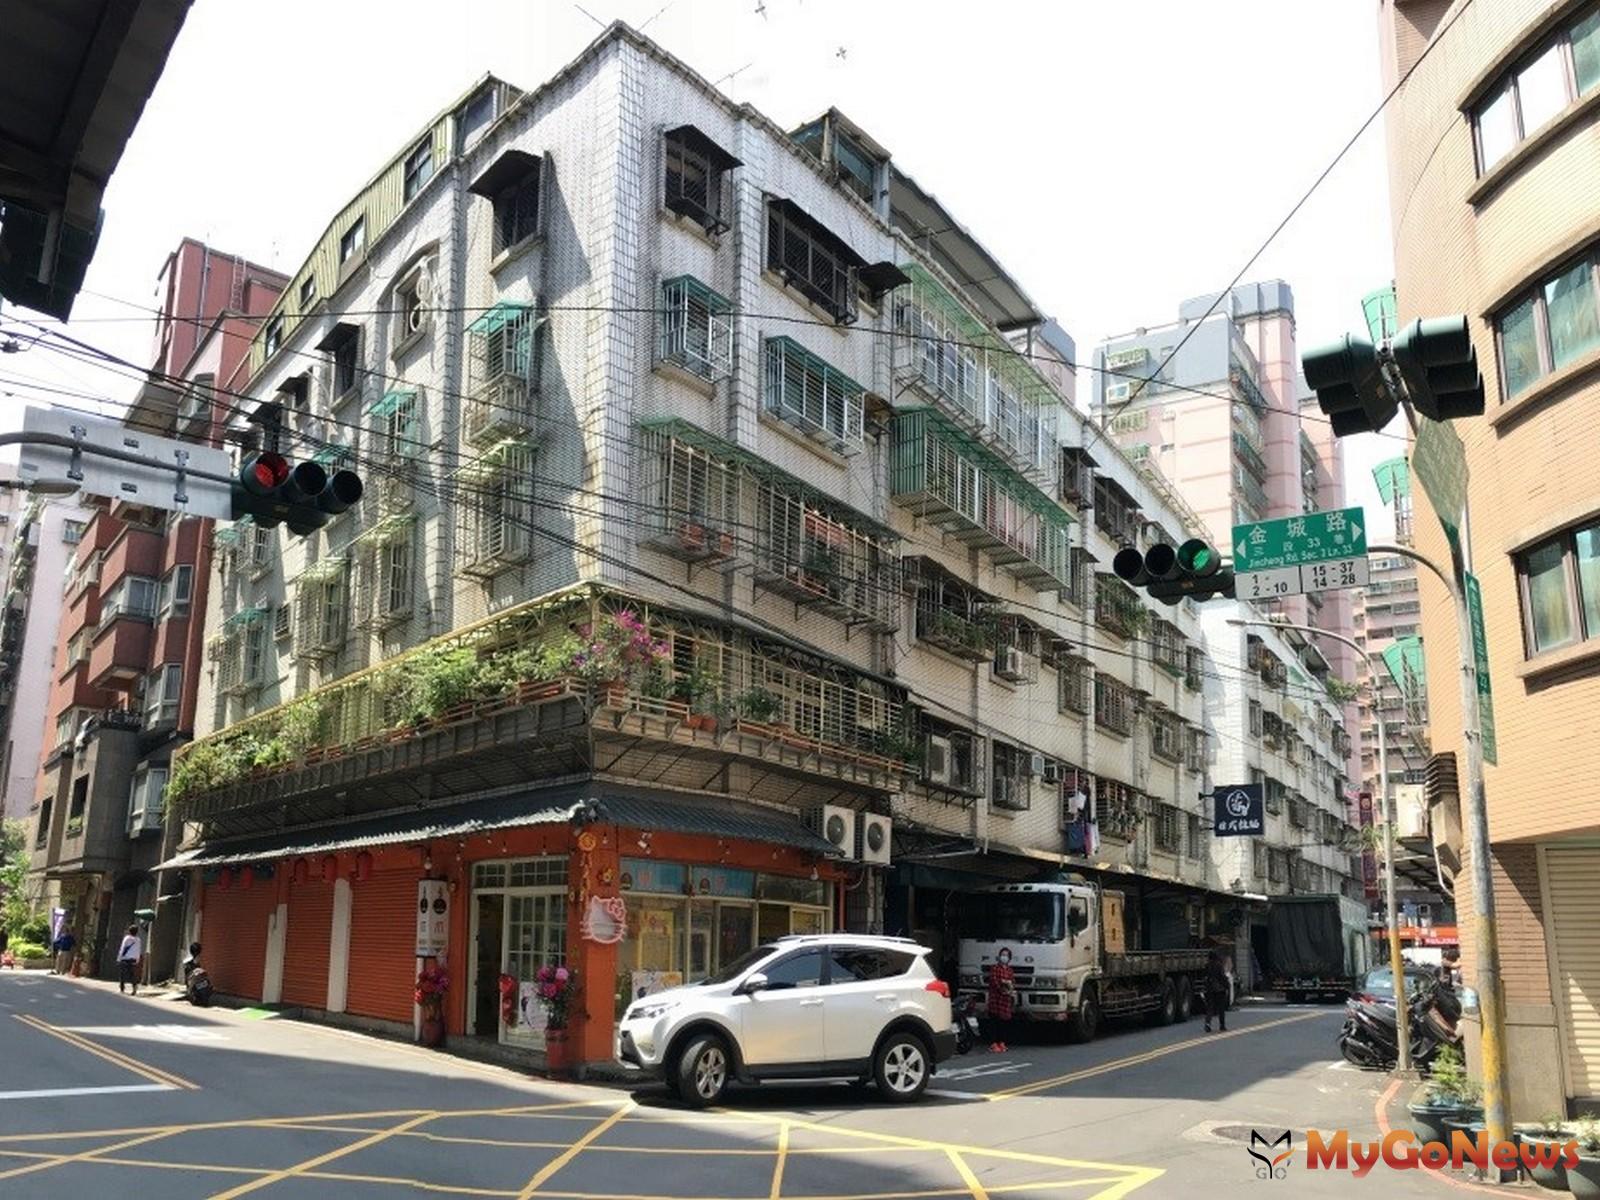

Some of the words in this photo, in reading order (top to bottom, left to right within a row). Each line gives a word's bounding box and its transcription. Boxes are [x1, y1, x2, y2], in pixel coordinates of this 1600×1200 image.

[1248, 512, 1347, 544] 金城路
[1313, 565, 1326, 577] 15
[1340, 562, 1354, 573] 37
[1313, 577, 1327, 588] 14
[1340, 573, 1356, 585] 28
[1253, 586, 1260, 596] 2
[1274, 582, 1288, 593] 10
